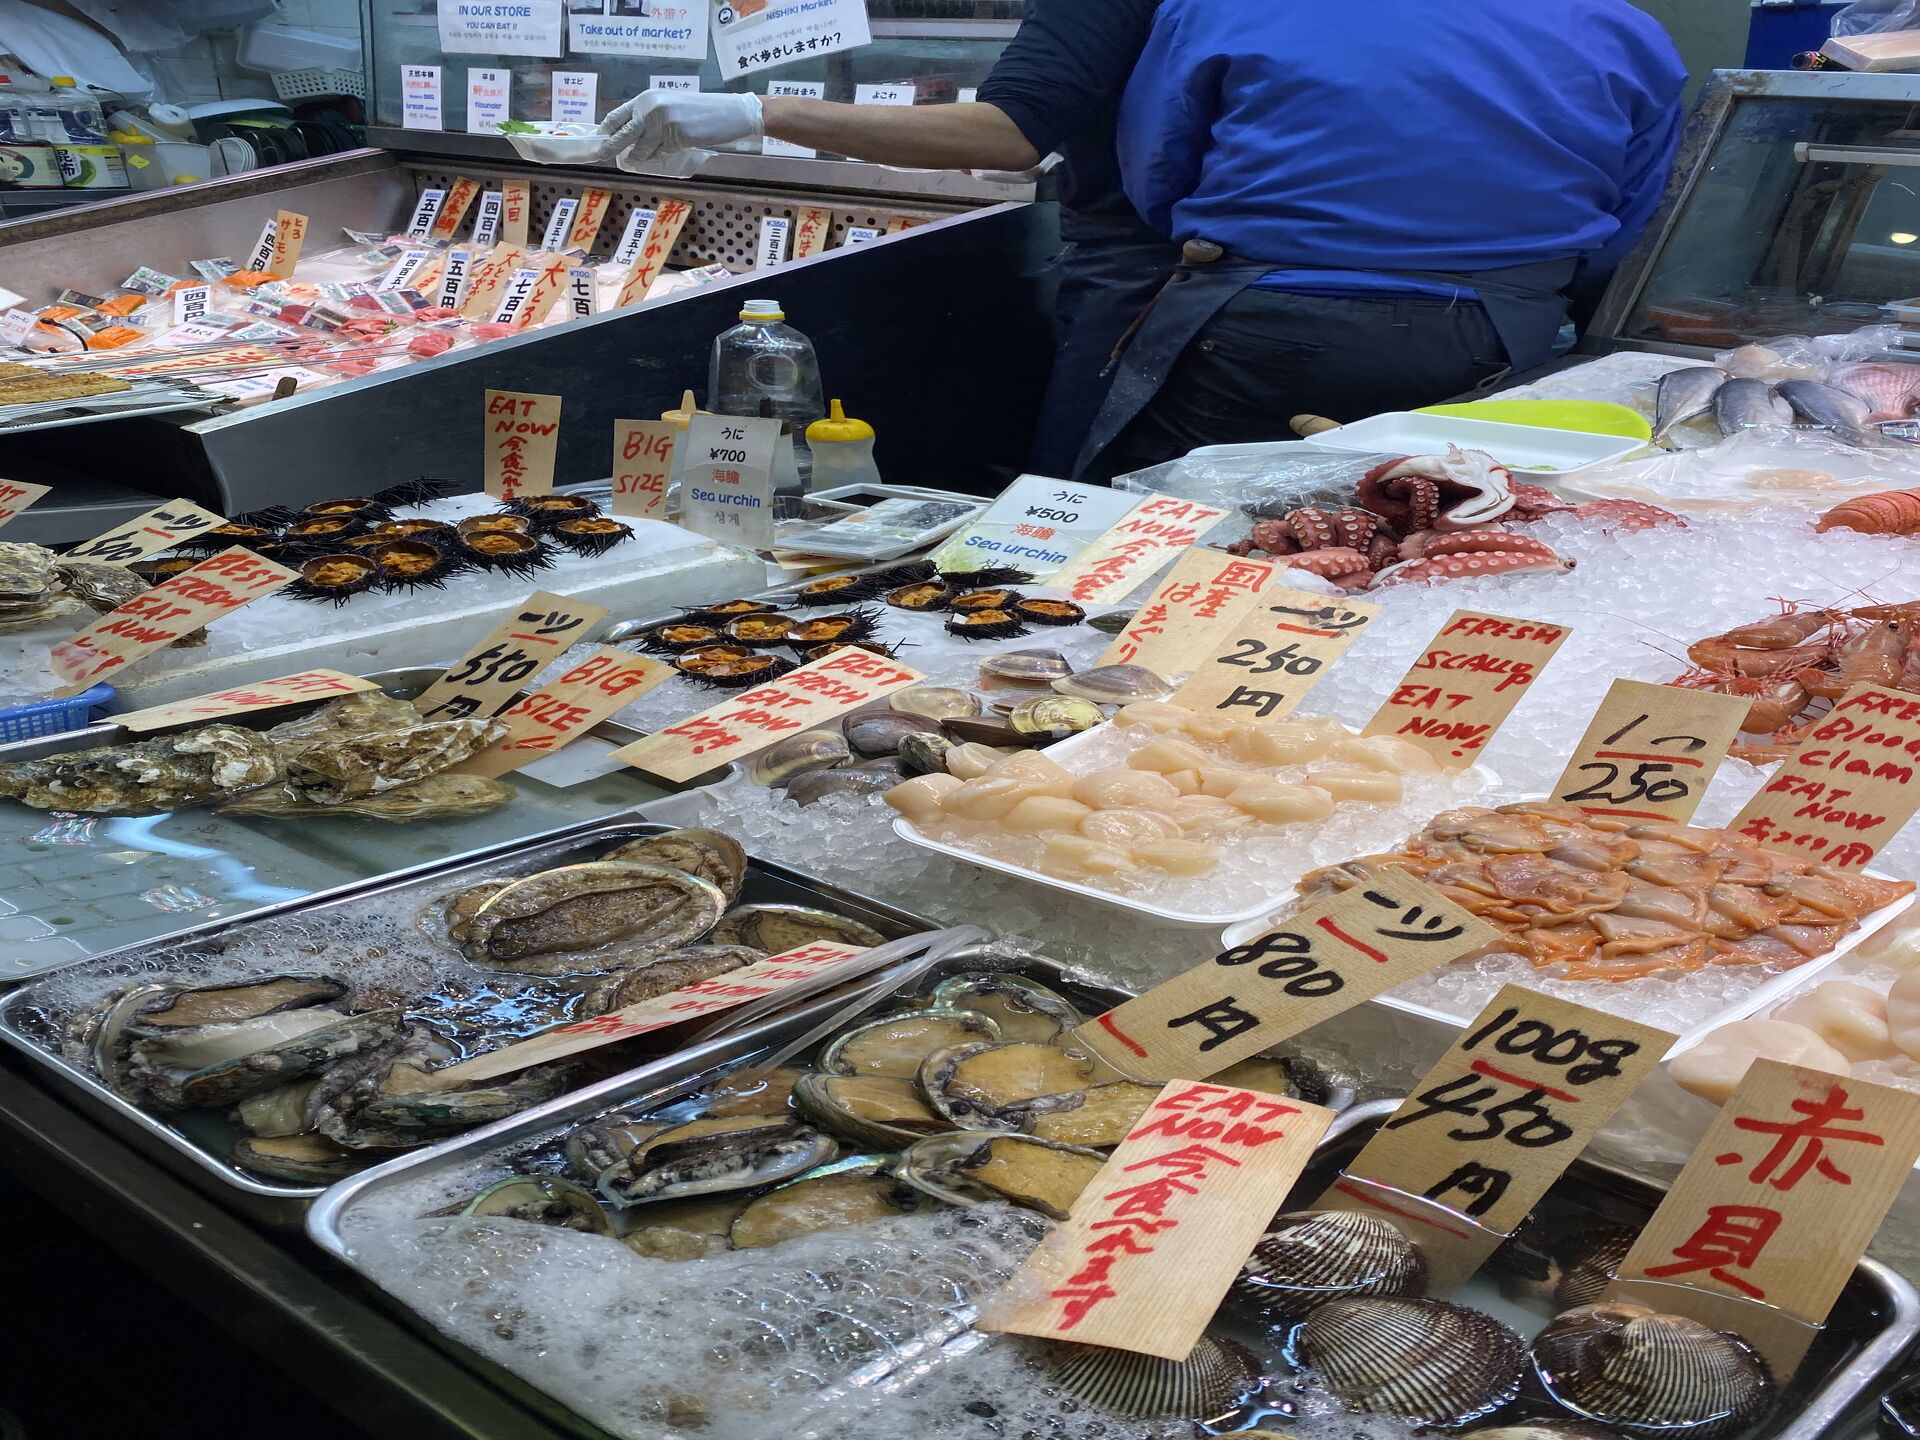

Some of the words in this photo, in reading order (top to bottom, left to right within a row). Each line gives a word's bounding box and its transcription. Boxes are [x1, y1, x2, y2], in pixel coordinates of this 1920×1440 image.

[459, 5, 468, 15] IN
[471, 6, 492, 16] OUR
[494, 6, 531, 17] STORE
[766, 5, 799, 21] NISHIKI
[481, 22, 495, 30] CAN
[580, 24, 602, 35] Take
[605, 26, 623, 36] out
[626, 26, 639, 37] of
[641, 28, 692, 39] market?
[737, 32, 841, 69] 食べ歩きしますか?
[774, 86, 817, 97] 天然はまち
[872, 90, 897, 100] よこわ
[573, 190, 605, 243] 甘えび
[488, 395, 537, 416] EAT
[495, 420, 557, 436] NOW
[721, 427, 744, 440] うに
[622, 431, 673, 462] BIG
[709, 447, 746, 463] ¥700
[614, 473, 665, 494] SIZE
[691, 488, 716, 502] Sea
[718, 493, 761, 508] urchin
[1053, 491, 1087, 504] うに
[714, 511, 740, 527] 성게
[1024, 505, 1079, 523] ¥500
[1139, 500, 1220, 524] EAT
[965, 535, 1000, 551] Sea
[1005, 544, 1068, 564] urchin
[193, 553, 287, 591] BEST
[151, 575, 251, 608] FRESH
[1190, 560, 1273, 618] 国産
[113, 596, 192, 622] EAT
[1119, 582, 1201, 665] はまぐり
[96, 618, 177, 644] NOW
[1442, 616, 1563, 646] FRESH
[445, 643, 539, 686] 550
[817, 653, 914, 686] BEST
[1217, 638, 1323, 675] 250
[560, 655, 646, 696] BIG
[777, 671, 869, 704] FRESH
[735, 688, 812, 708] EAT
[1216, 685, 1285, 717] 円
[1389, 684, 1475, 711] EAT
[506, 694, 592, 732] SIZE
[719, 708, 803, 731] NOW
[1561, 762, 1690, 805] 250
[1765, 775, 1852, 803] EAT
[1793, 802, 1886, 830] NOW
[767, 947, 858, 965] EAT
[1215, 932, 1345, 999] 800
[1168, 997, 1260, 1052] 円
[1461, 1007, 1640, 1086] 100g
[1155, 1085, 1303, 1122] EAT
[1385, 1072, 1574, 1149] 450
[1126, 1112, 1284, 1147] NOW
[1425, 1160, 1514, 1216] 円
[1643, 1082, 1886, 1300] 赤貝
